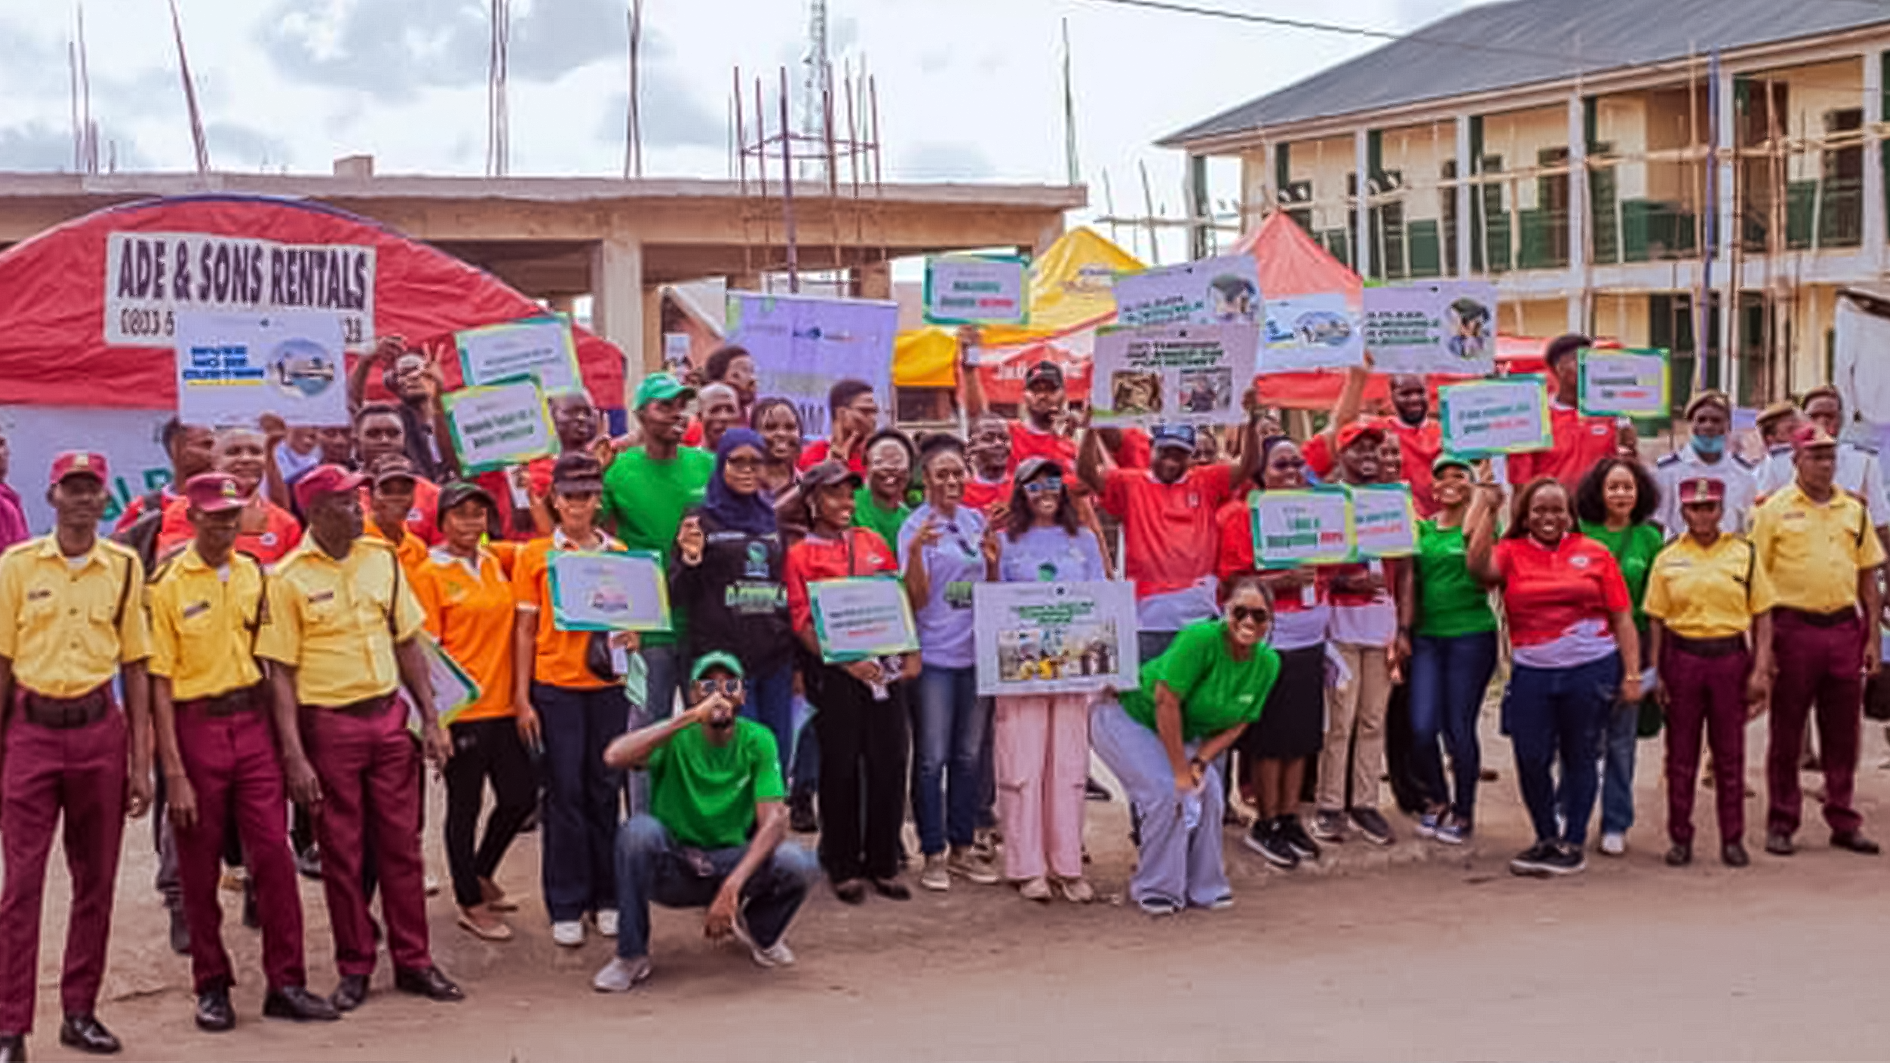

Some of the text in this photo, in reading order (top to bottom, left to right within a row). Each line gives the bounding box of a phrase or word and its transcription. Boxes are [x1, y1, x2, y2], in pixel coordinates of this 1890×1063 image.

[118, 238, 366, 311] ADE & SONS RENTALS
